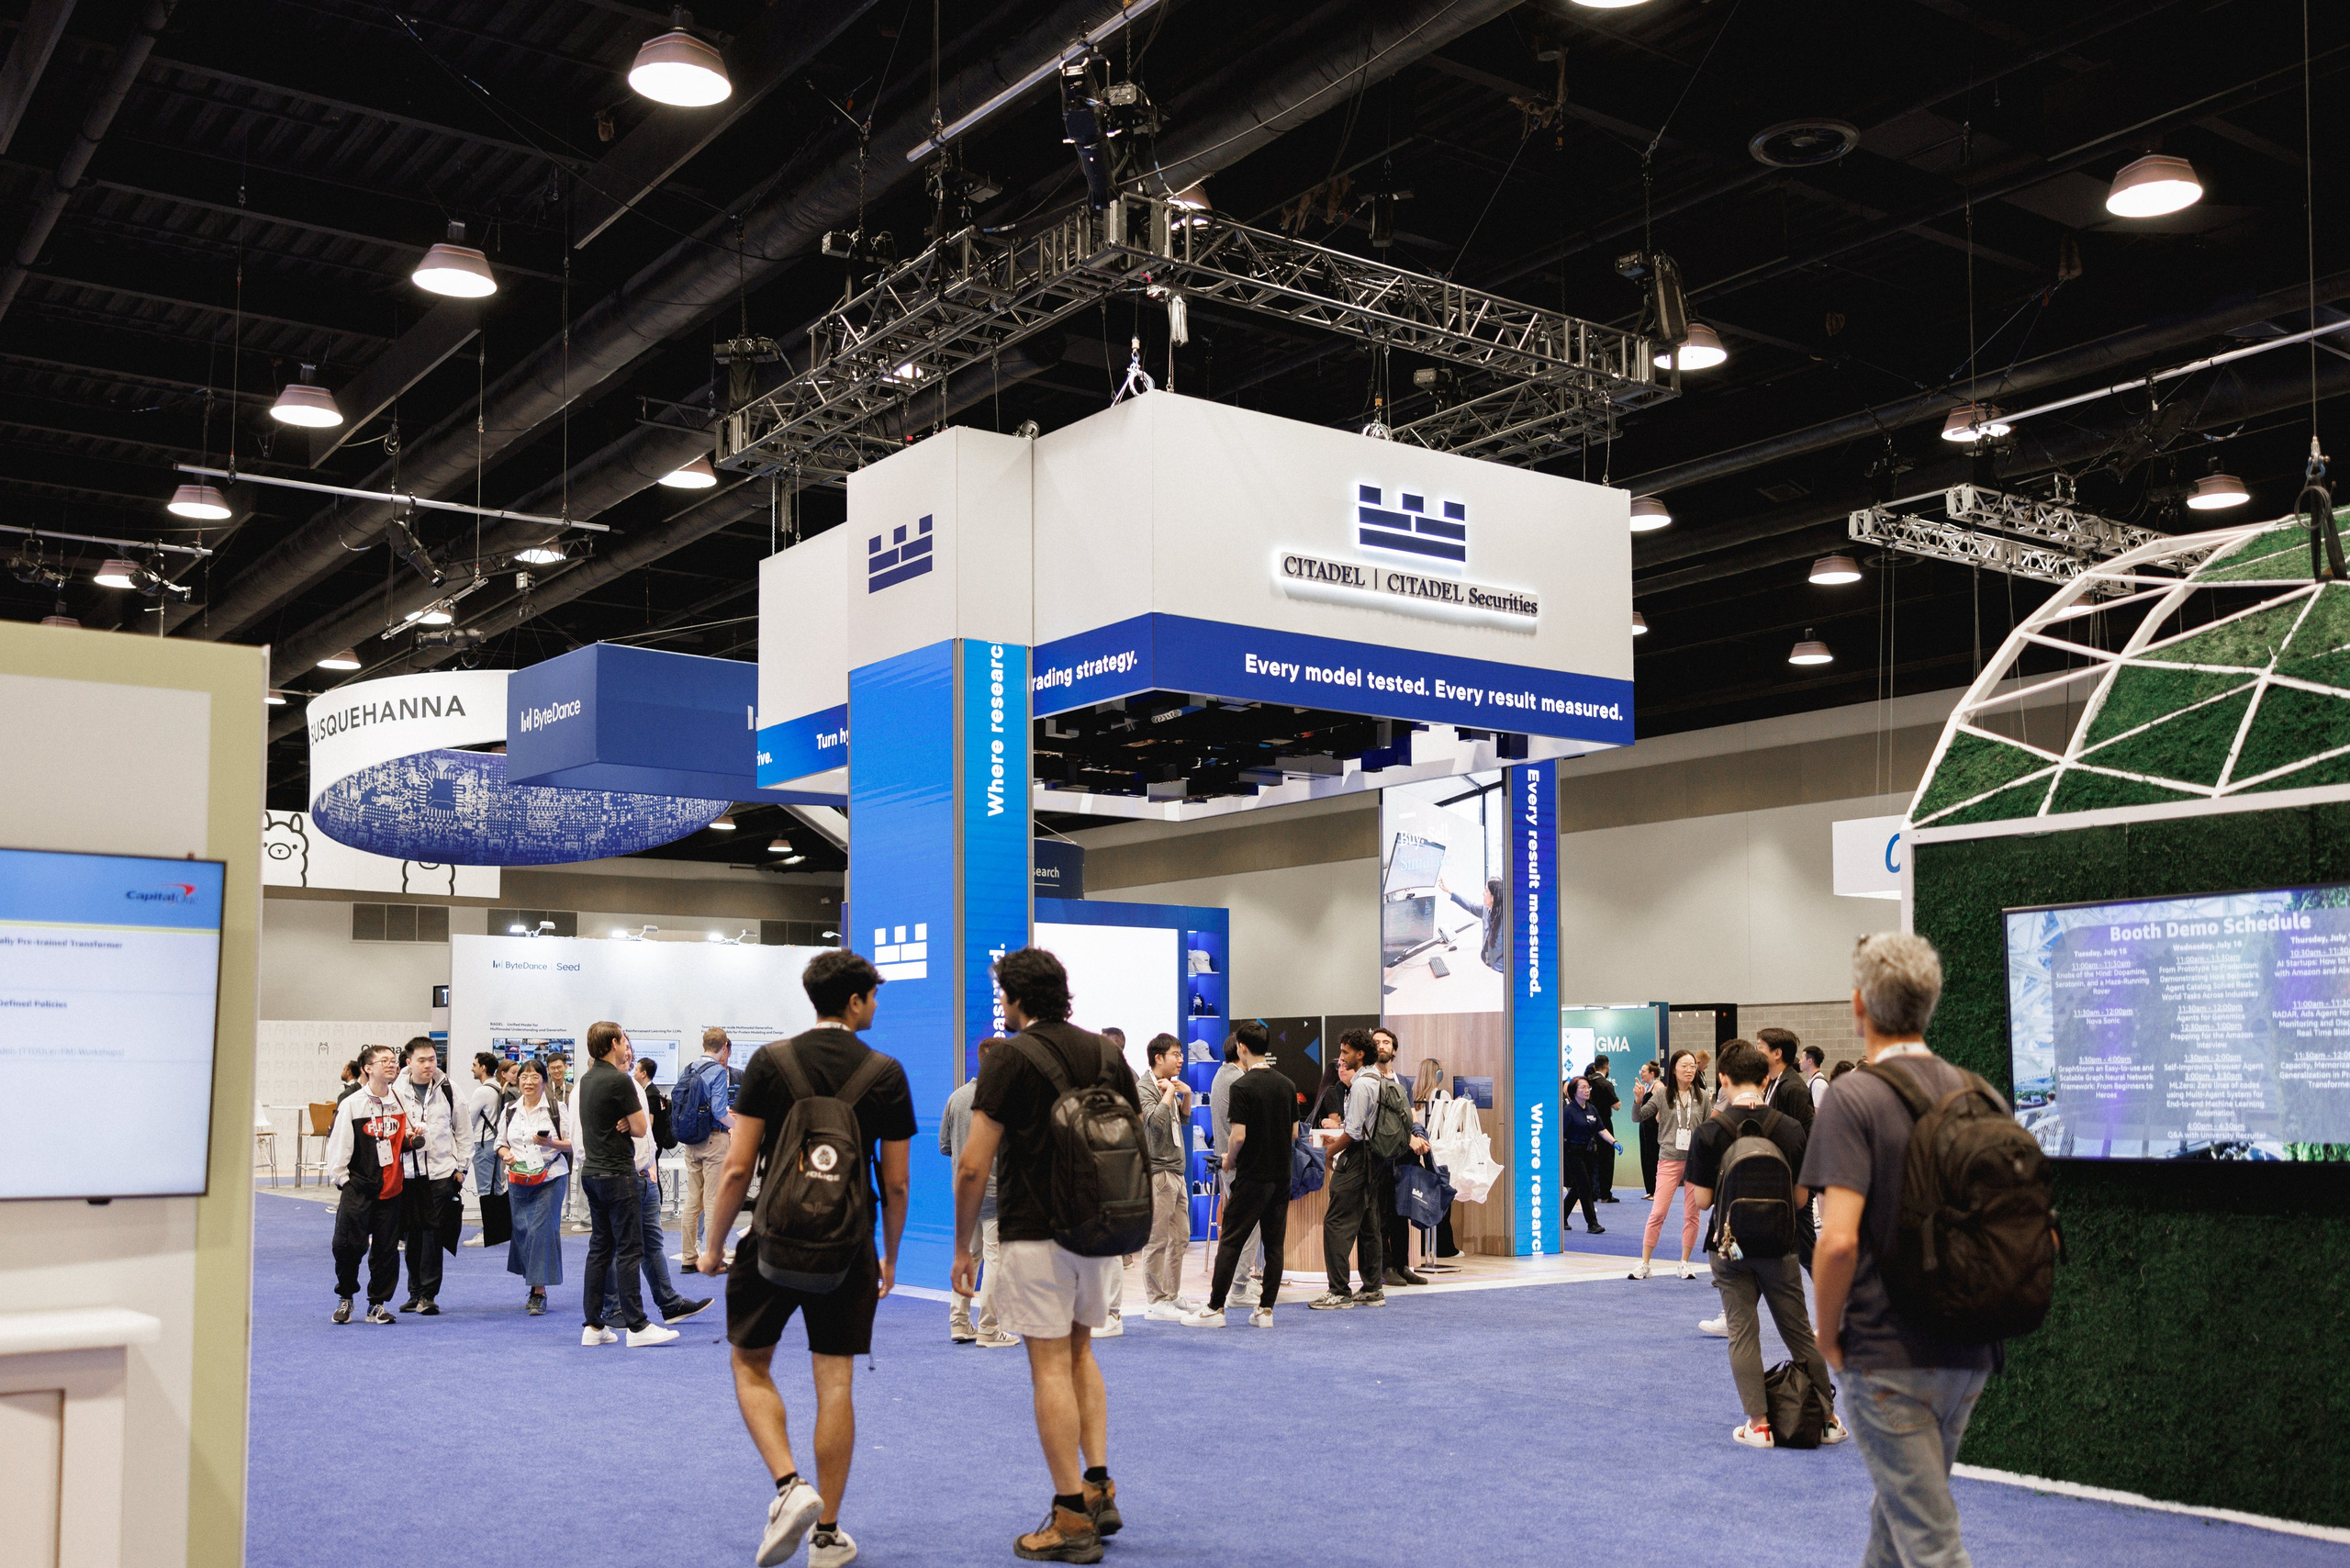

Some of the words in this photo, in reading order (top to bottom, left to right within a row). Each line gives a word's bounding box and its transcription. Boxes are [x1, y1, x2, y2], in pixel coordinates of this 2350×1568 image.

[1283, 555, 1366, 586] CITADEL
[1386, 573, 1464, 602] CITADEL
[1469, 587, 1538, 614] Securities
[1076, 650, 1138, 680] strategy.
[1245, 653, 1300, 683] Every
[1305, 666, 1362, 687] model
[1367, 671, 1430, 696] tested.
[1435, 678, 1483, 707] Every
[1488, 690, 1537, 711] result
[1541, 696, 1623, 722] measured.
[310, 694, 466, 746] SUSQUEHANNA
[533, 699, 581, 732] ByteDance
[816, 733, 838, 750] Turn
[987, 739, 1004, 817] Where
[1525, 768, 1540, 826] Every
[1528, 830, 1540, 889] result
[2110, 923, 2161, 941] Booth
[2166, 921, 2218, 938] Demo
[2223, 912, 2311, 935] Schedule
[2289, 935, 2328, 944] Thursday,
[2330, 933, 2346, 943] July
[71, 939, 123, 949] Transformer
[1528, 893, 1541, 998] measured.
[2173, 942, 2215, 951] Wednesday,
[2216, 941, 2232, 949] July
[2074, 949, 2102, 958] Tuesday,
[2103, 948, 2117, 958] July
[505, 960, 547, 970] ByteDance
[556, 962, 581, 971] Seed
[2177, 965, 2210, 973] Prototype
[2274, 969, 2290, 978] with
[2291, 969, 2321, 977] Amazon
[2322, 967, 2336, 975] and
[2105, 977, 2150, 986] Maze-Running
[2159, 973, 2209, 983] Demonstrating
[2165, 984, 2185, 992] Agent
[2186, 982, 2211, 991] Catalog
[2212, 981, 2234, 990] Solves
[2161, 992, 2182, 1001] World
[2182, 991, 2201, 1000] Tasks
[2225, 990, 2259, 998] Industries
[2177, 1014, 2199, 1023] Agents
[2200, 1013, 2210, 1021] for
[2211, 1013, 2245, 1021] Genomics
[2315, 1009, 2337, 1018] Agent
[2278, 1019, 2318, 1029] Monitoring
[2320, 1019, 2333, 1027] and
[2170, 1033, 2200, 1041] Prepping
[2225, 1031, 2254, 1039] Amazon
[2296, 1028, 2312, 1036] Real
[2313, 1028, 2332, 1036] Time
[2058, 1065, 2095, 1073] GraphStorm
[2104, 1064, 2142, 1073] Easy-to-use
[2243, 1062, 2265, 1072] Agent
[2085, 1074, 2104, 1082] Graph
[2105, 1073, 2126, 1081] Neural
[2278, 1070, 2333, 1080] Generalization
[2113, 1082, 2145, 1091] Beginners
[2197, 1081, 2212, 1090] Zero
[2166, 1092, 2185, 1100] using
[2185, 1091, 2225, 1100] Multi-Agent
[2226, 1091, 2252, 1100] System
[2253, 1090, 2264, 1098] for
[2166, 1100, 2204, 1108] End-to-end
[2205, 1100, 2233, 1108] Machine
[2234, 1100, 2266, 1109] Learning
[2195, 1109, 2235, 1117] Automation
[1530, 1103, 1543, 1170] Where
[2167, 1131, 2184, 1139] Q&A
[2199, 1131, 2234, 1140] University
[2235, 1131, 2266, 1139] Recruiter
